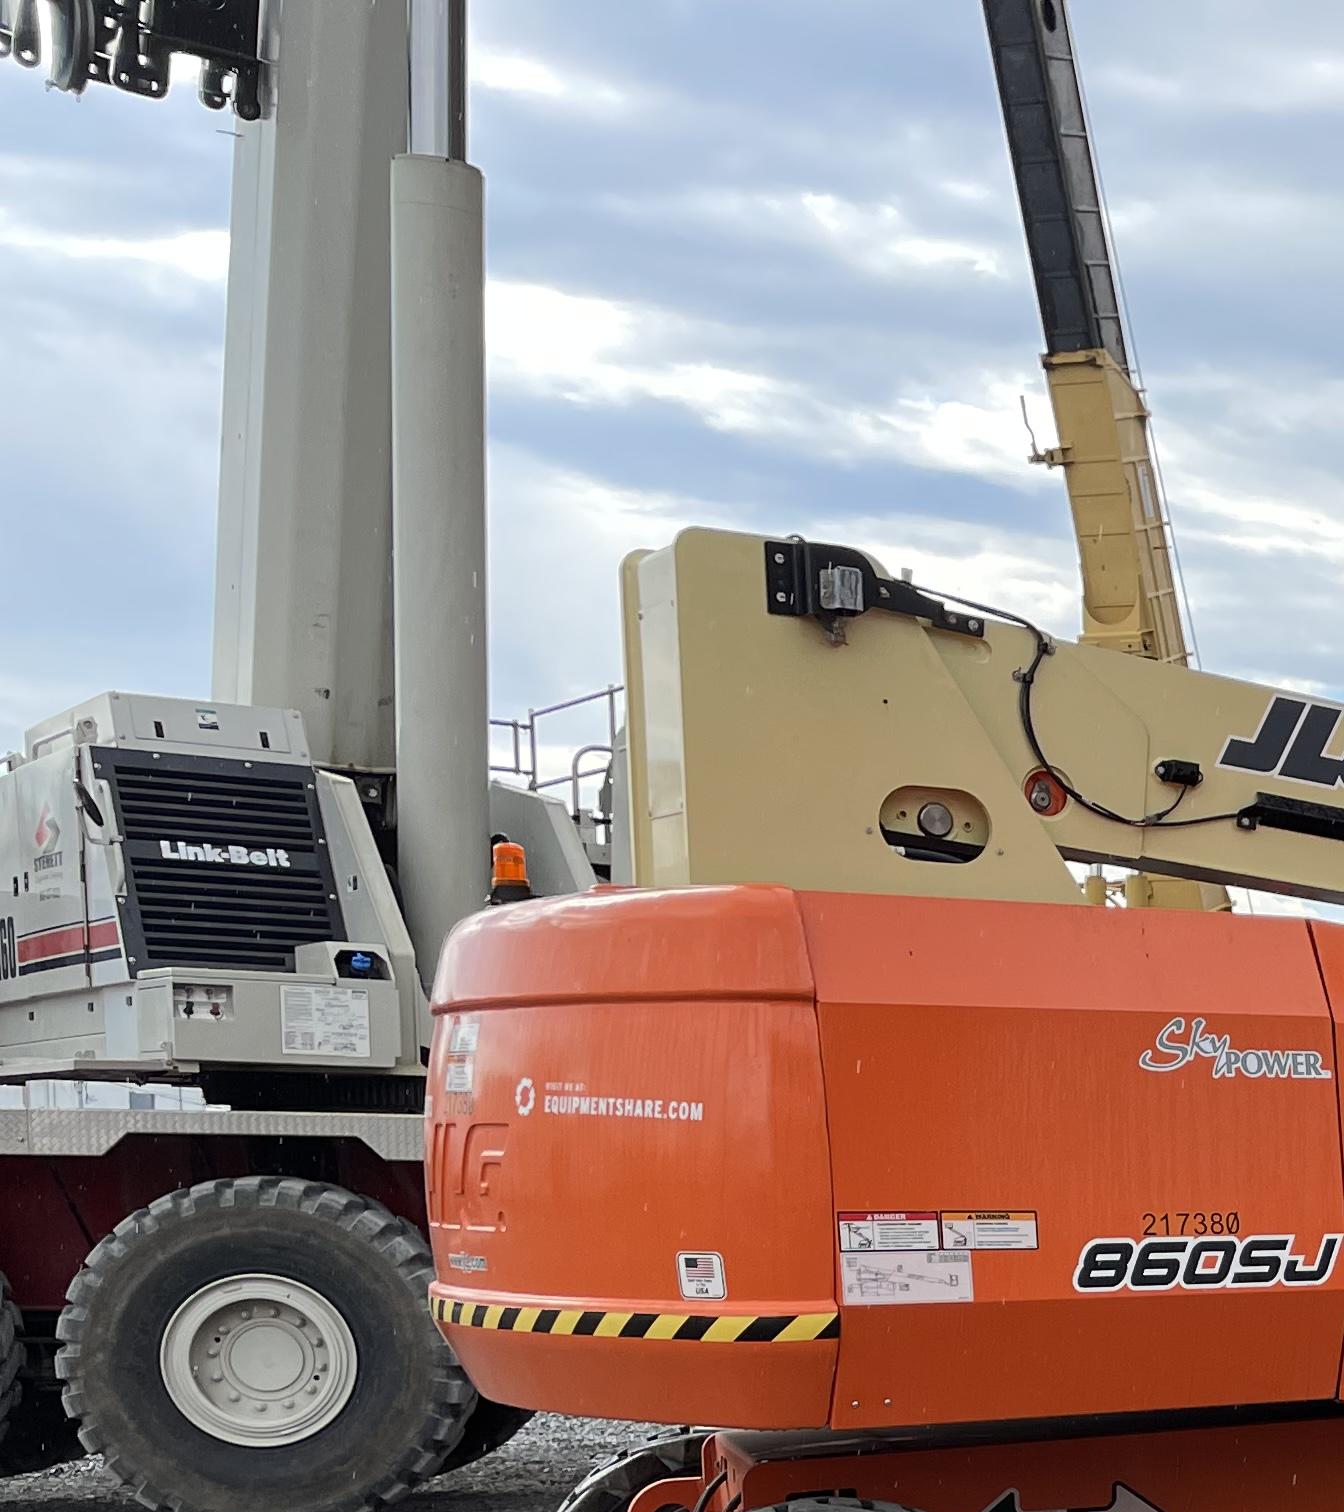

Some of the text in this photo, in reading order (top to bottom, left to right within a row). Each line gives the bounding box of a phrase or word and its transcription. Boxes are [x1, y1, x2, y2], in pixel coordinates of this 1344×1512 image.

[159, 840, 291, 867] Link-Belt
[0, 915, 17, 982] 60
[543, 1095, 704, 1121] EQUIPMENTSHARE.COM
[1141, 1211, 1241, 1236] 217380
[1075, 1236, 1341, 1290] 860SJ
